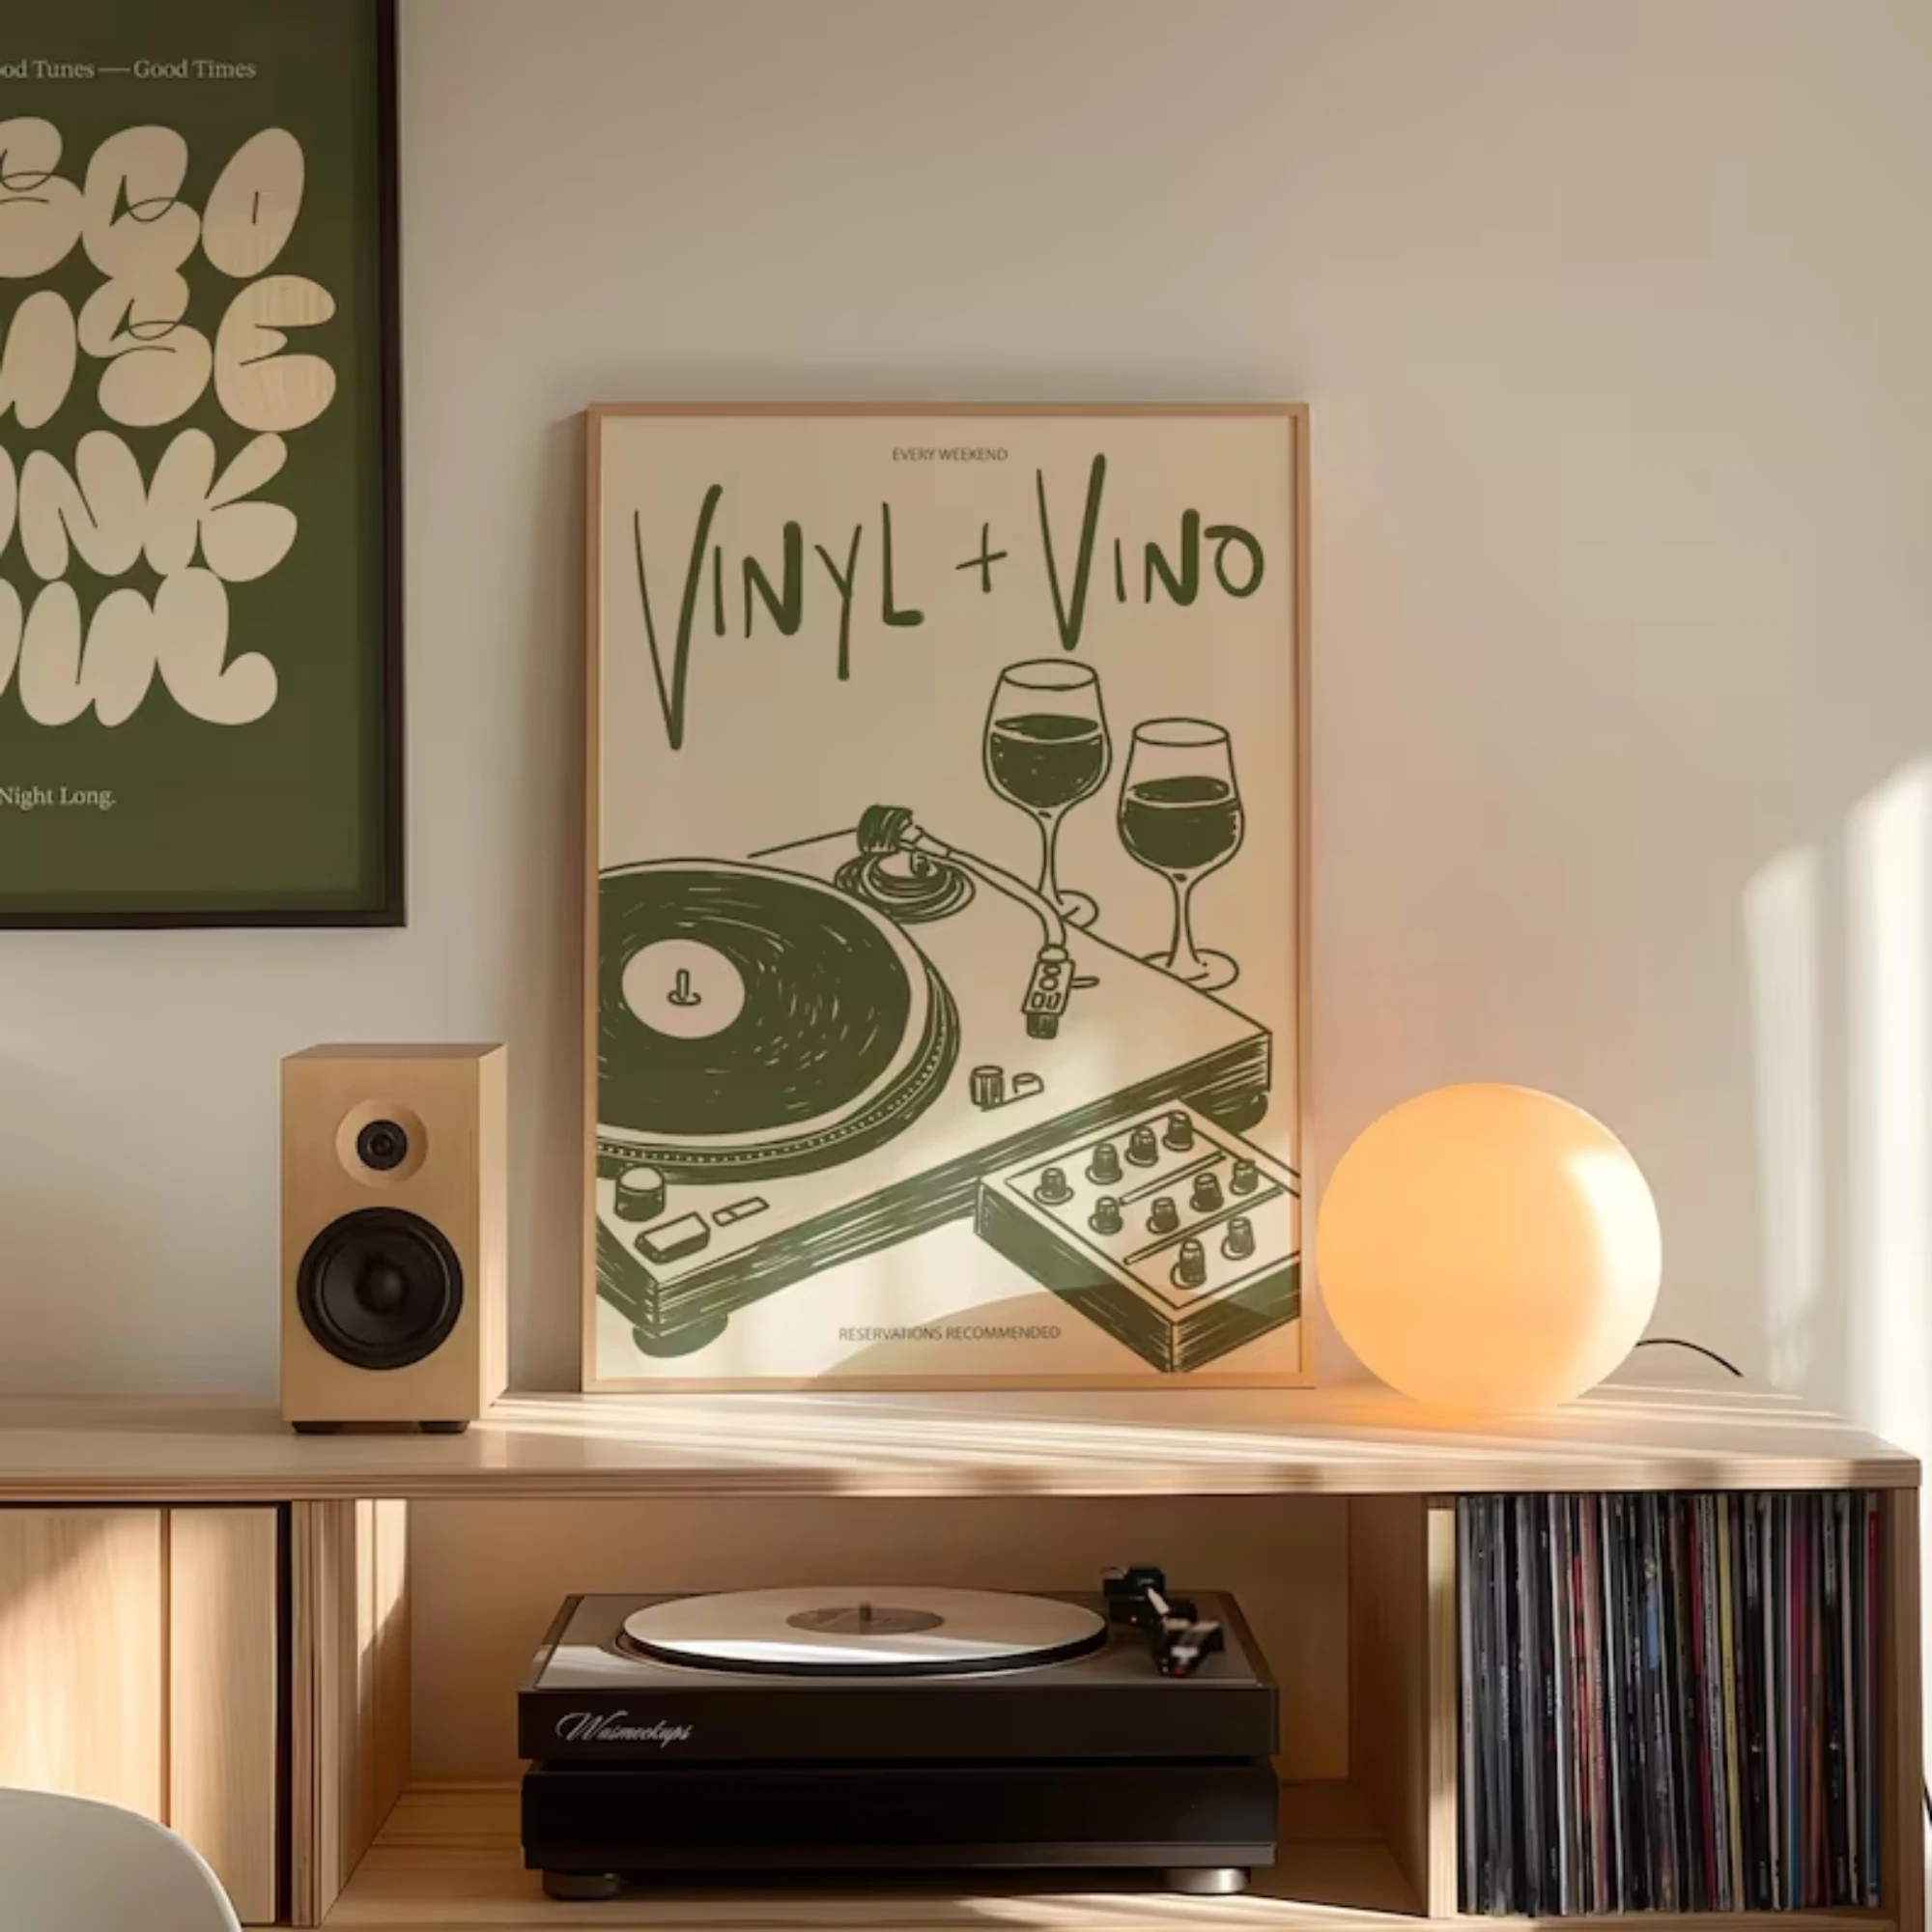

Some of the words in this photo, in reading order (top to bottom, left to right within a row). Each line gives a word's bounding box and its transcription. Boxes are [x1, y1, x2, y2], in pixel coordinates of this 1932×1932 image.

[0, 59, 28, 78] od
[32, 59, 96, 78] Tunes
[133, 59, 188, 78] Good
[192, 59, 257, 78] Times
[892, 447, 936, 461] EVERY
[938, 447, 1009, 461] WEEKEND
[0, 428, 298, 582] NK
[634, 484, 923, 752] VINYL
[1036, 454, 1264, 652] VINO
[0, 566, 278, 727] UL
[0, 785, 53, 810] Night
[60, 785, 117, 810] Long.
[838, 1324, 943, 1340] RESERVATIONS
[946, 1324, 1062, 1340] RECOMMENDED
